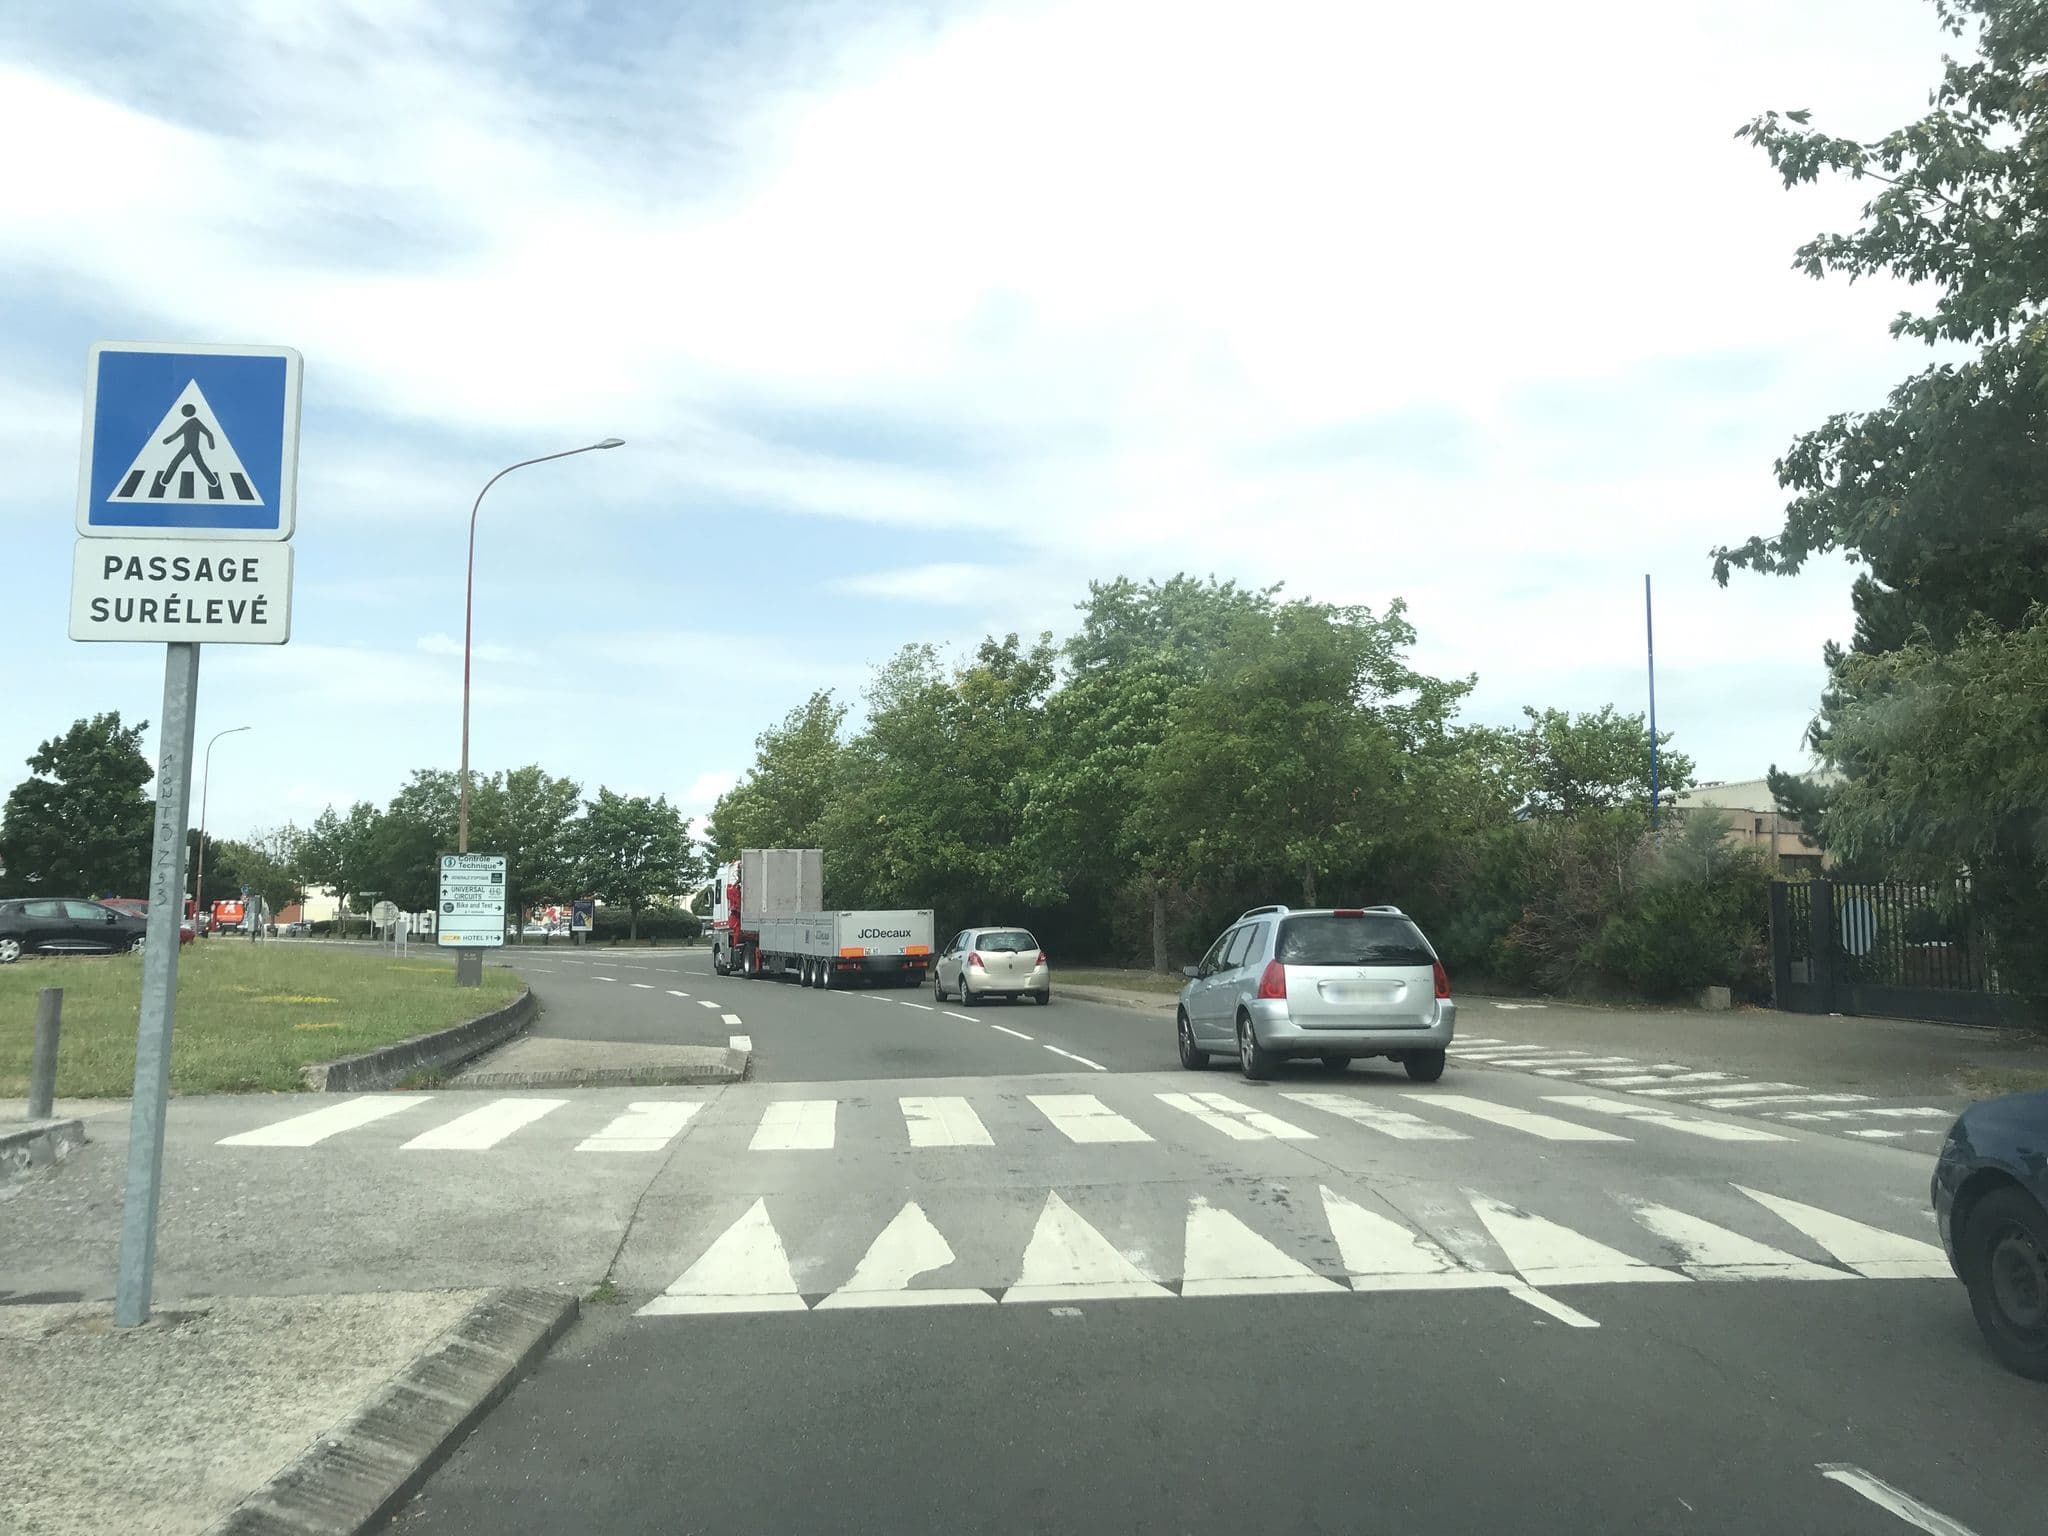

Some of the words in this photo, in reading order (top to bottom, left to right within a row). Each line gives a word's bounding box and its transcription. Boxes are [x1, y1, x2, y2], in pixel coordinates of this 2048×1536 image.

[103, 555, 259, 583] PASSAGE
[89, 593, 268, 624] SURÉLEVÉ
[458, 862, 497, 870] Technique
[857, 928, 912, 939] JCDecaux
